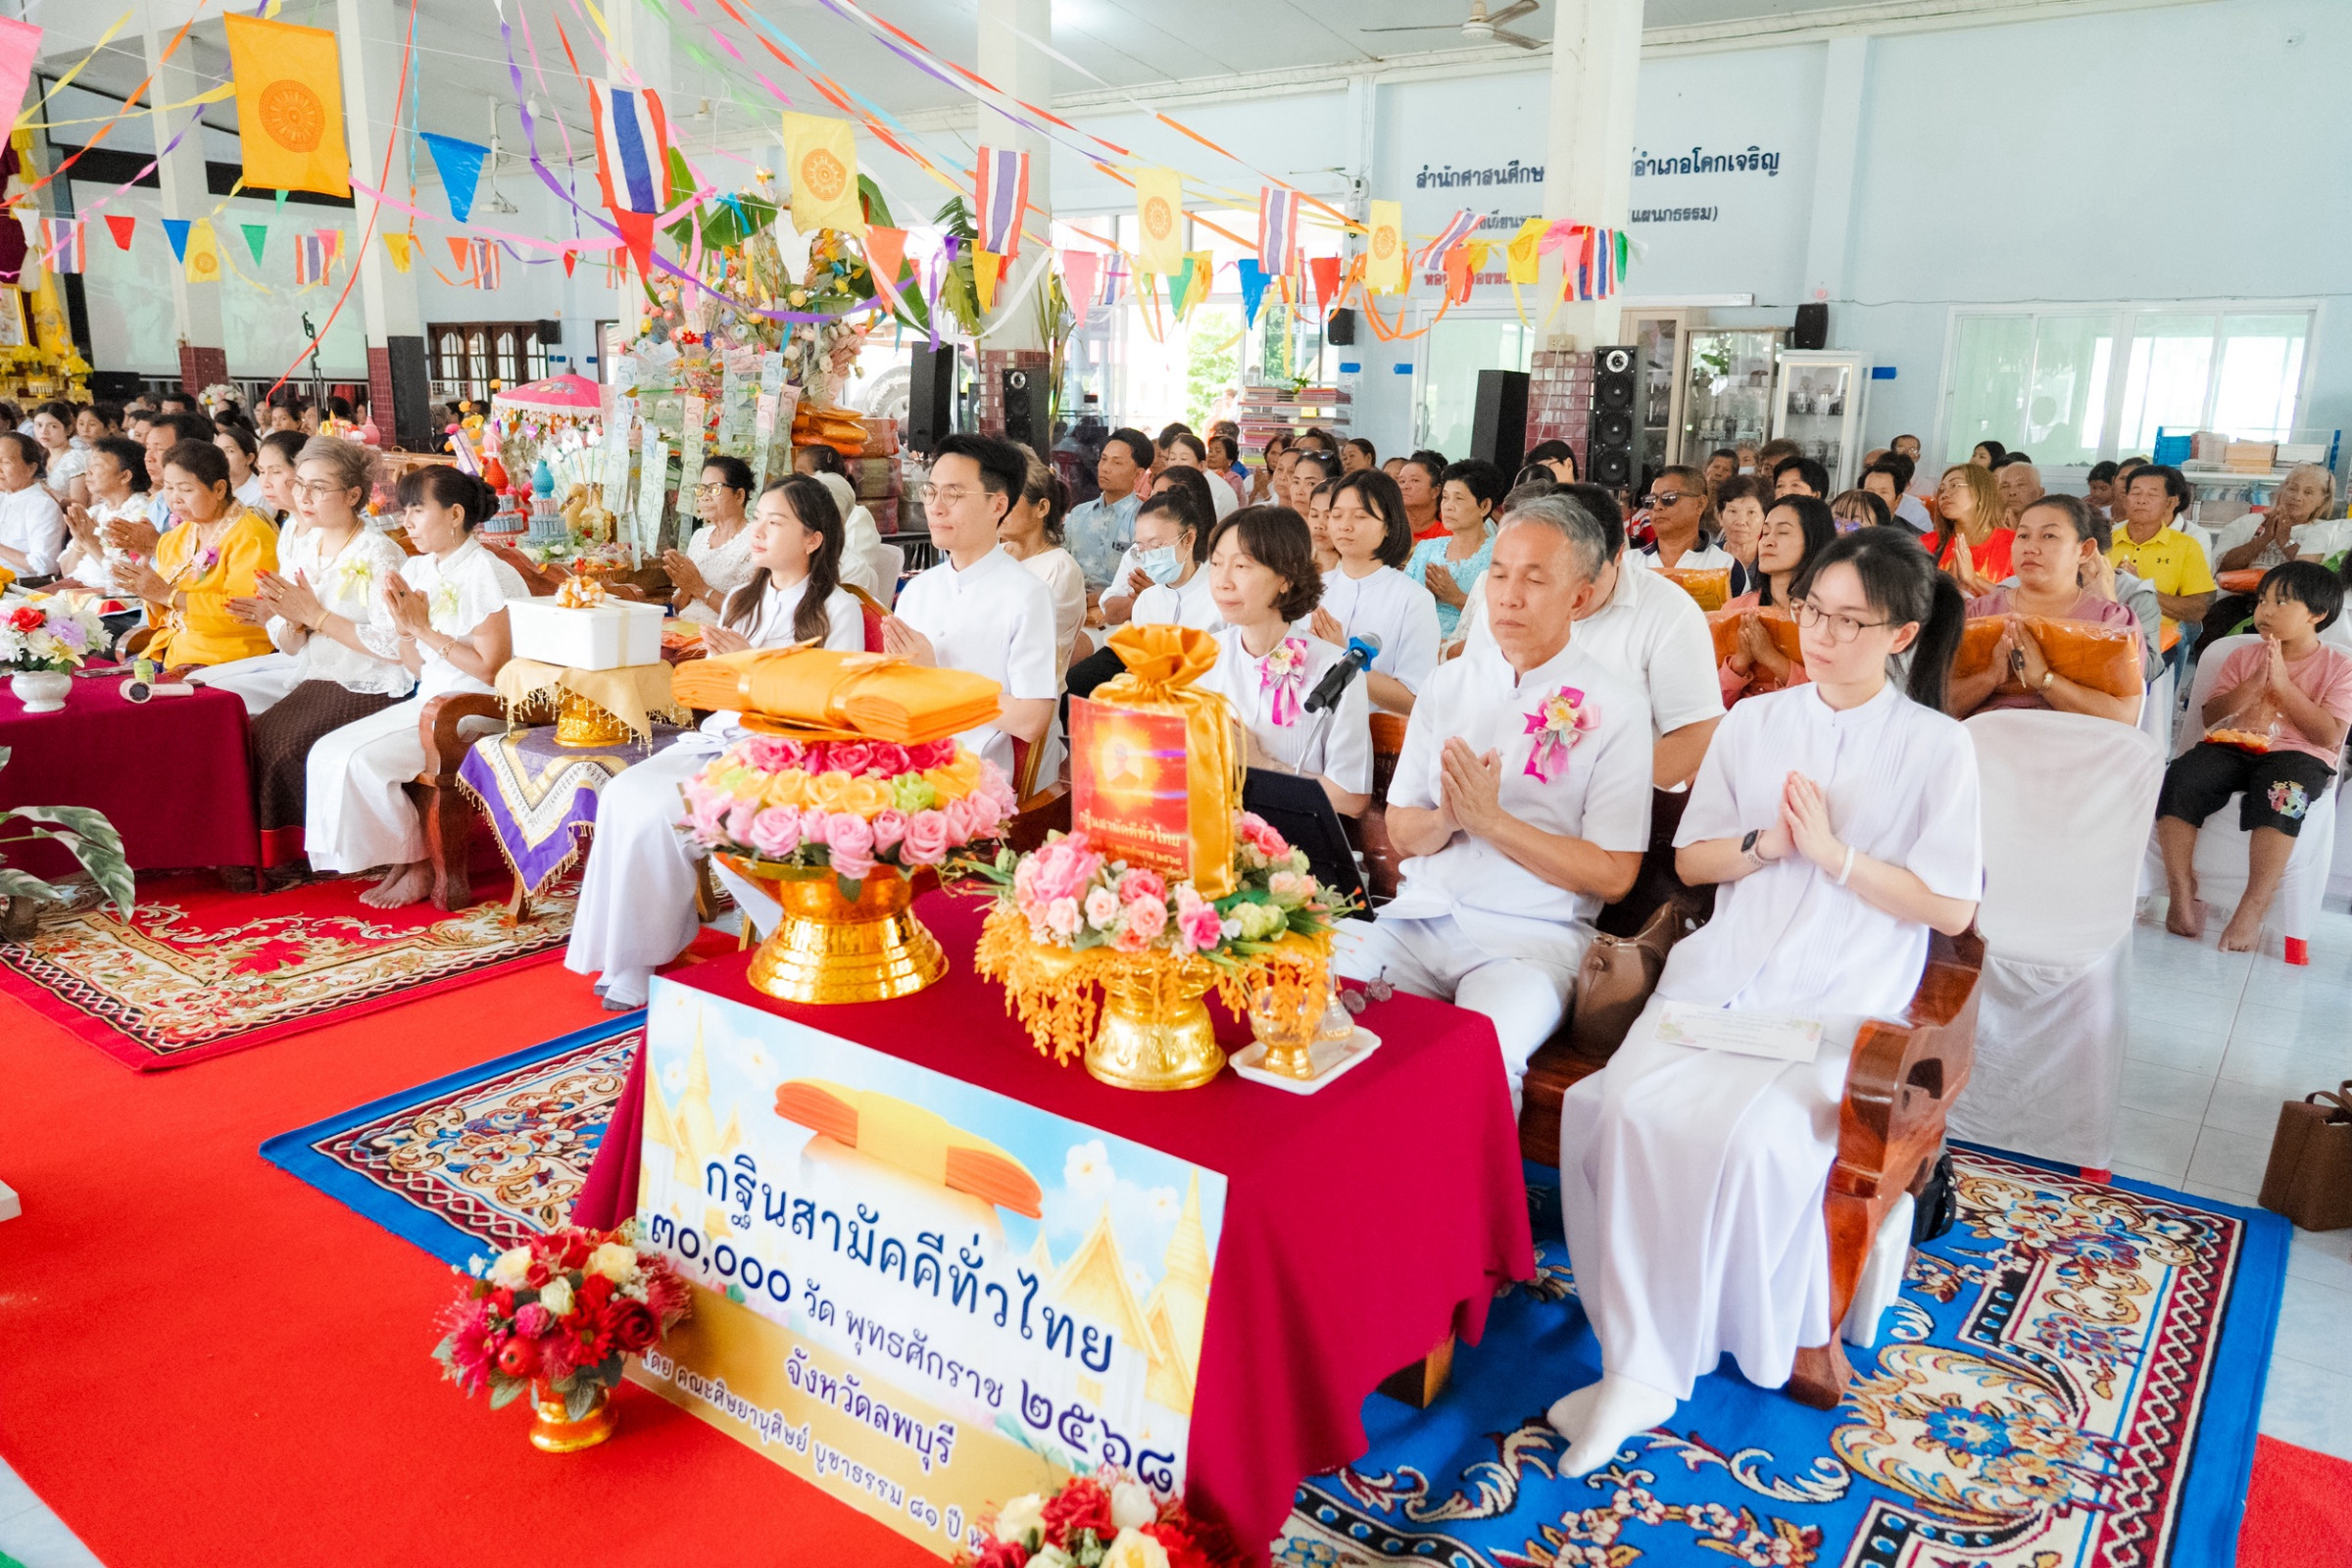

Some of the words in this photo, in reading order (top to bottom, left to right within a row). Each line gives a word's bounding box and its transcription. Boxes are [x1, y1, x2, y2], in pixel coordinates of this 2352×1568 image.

[1415, 159, 1544, 189] สำนักศาสนศึกษ
[1631, 146, 1781, 177] อำเภอโคกเจริญ
[706, 1153, 1113, 1373] กฐินสามัคคีทั่วไทย
[651, 1213, 792, 1303] ๓๐,๐๐๐
[804, 1278, 835, 1327] วัด
[846, 1309, 1004, 1408] พุทธศักราช
[1021, 1379, 1175, 1494] ๒๕๖๘
[786, 1348, 955, 1472] จังหวัดลพบุรี
[676, 1368, 808, 1452] คณะศิษยานุศิษย์
[815, 1443, 903, 1506] บูชาธรรม
[909, 1499, 937, 1527] ๘๑
[948, 1507, 961, 1538] ปี
